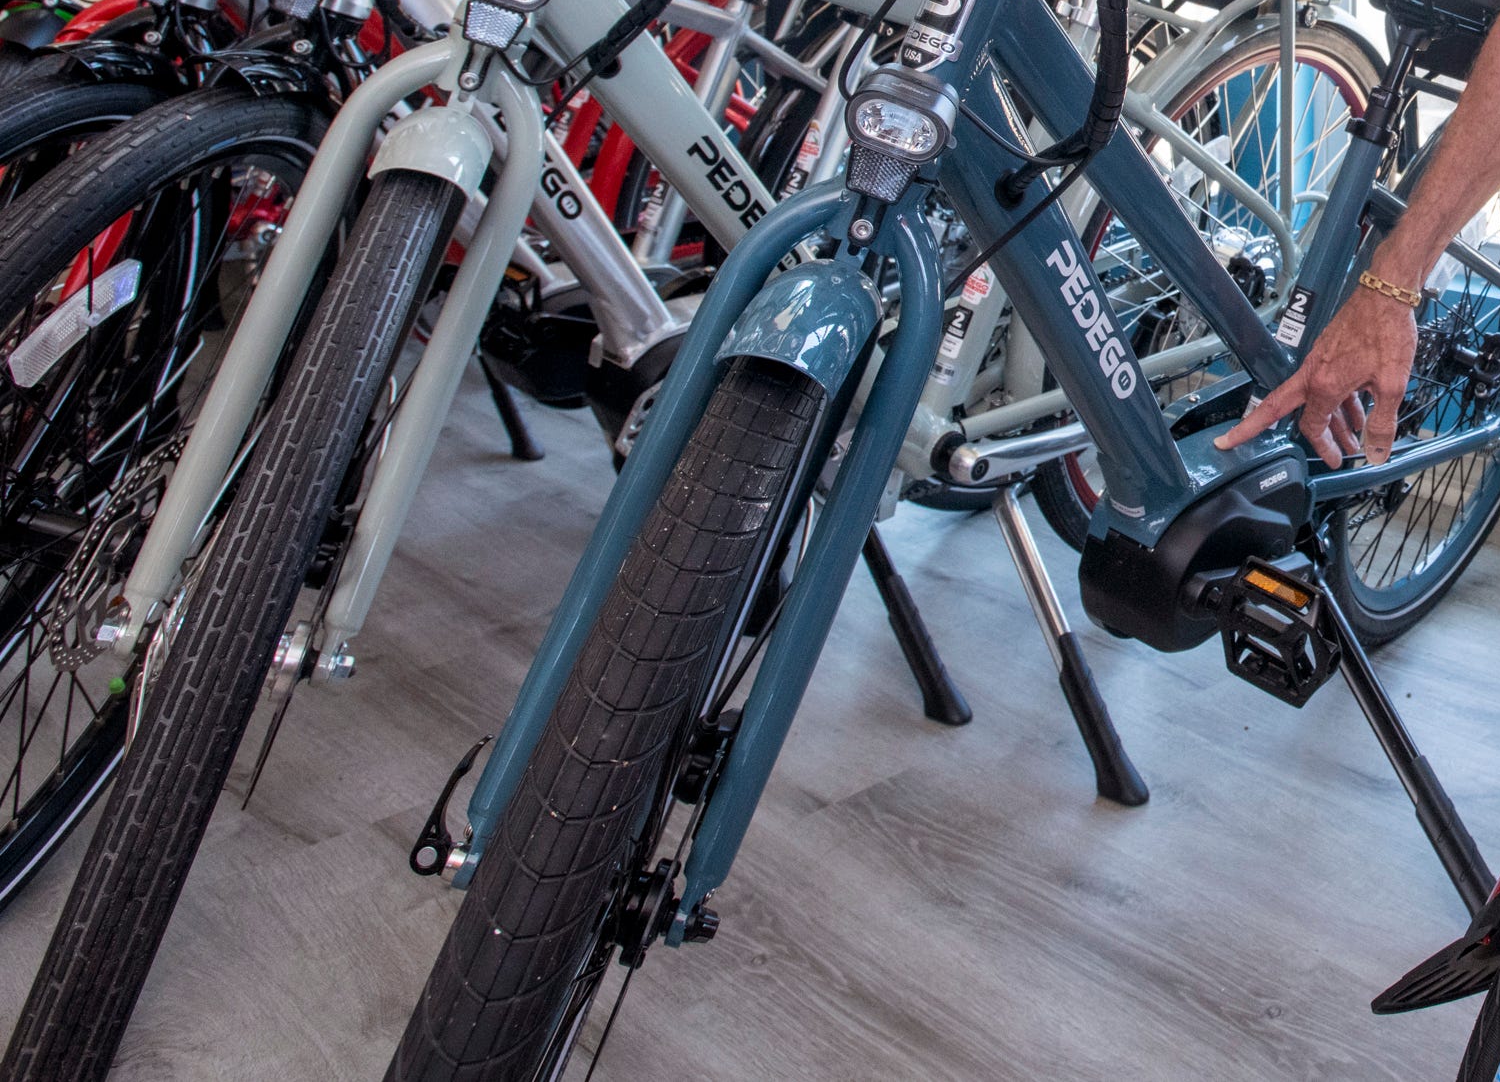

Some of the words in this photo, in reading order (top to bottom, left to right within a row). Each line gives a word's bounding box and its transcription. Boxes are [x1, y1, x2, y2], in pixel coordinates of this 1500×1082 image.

[904, 48, 923, 64] USA
[788, 172, 802, 189] 2
[652, 183, 665, 198] 2
[1290, 293, 1308, 314] 2
[951, 311, 966, 329] 2
[1046, 240, 1137, 399] PEDEGO
[1259, 470, 1288, 490] PEDEGO
